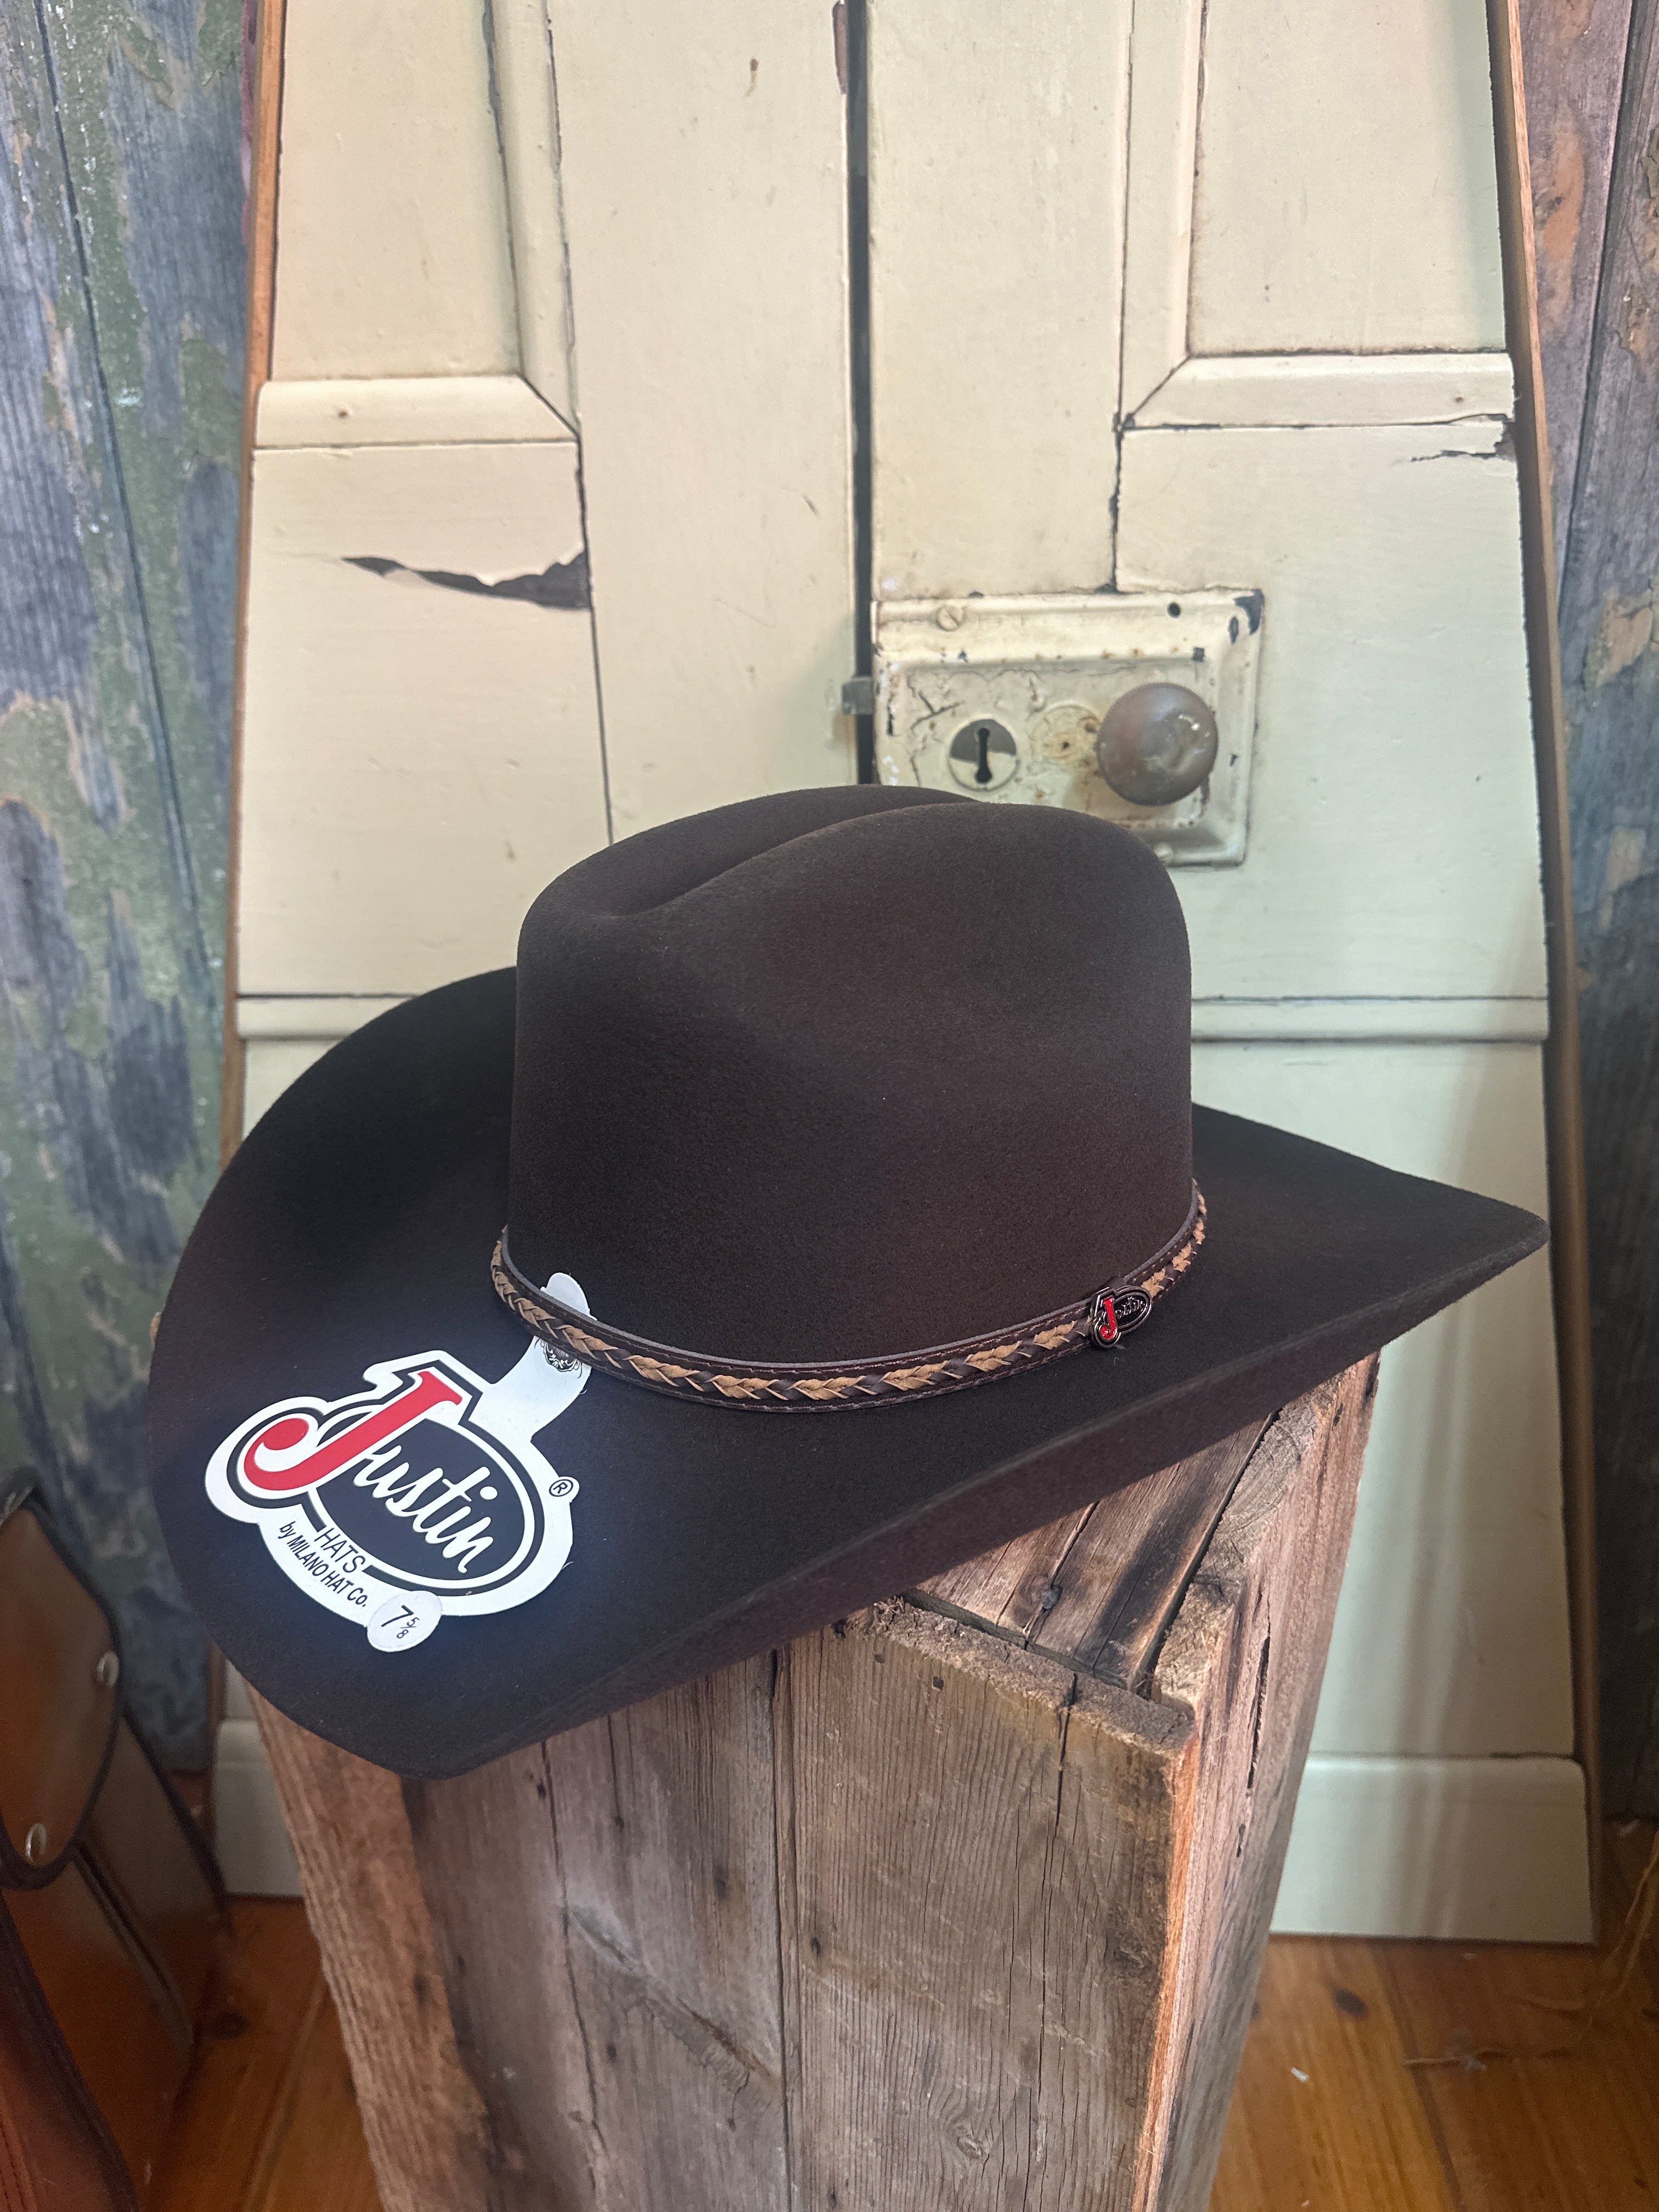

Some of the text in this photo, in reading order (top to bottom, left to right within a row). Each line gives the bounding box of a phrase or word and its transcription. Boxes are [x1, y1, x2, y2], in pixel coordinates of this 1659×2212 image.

[240, 1369, 498, 1573] Justin
[278, 1521, 368, 1607] by MILANO HAT Co.
[314, 1527, 366, 1573] HATS
